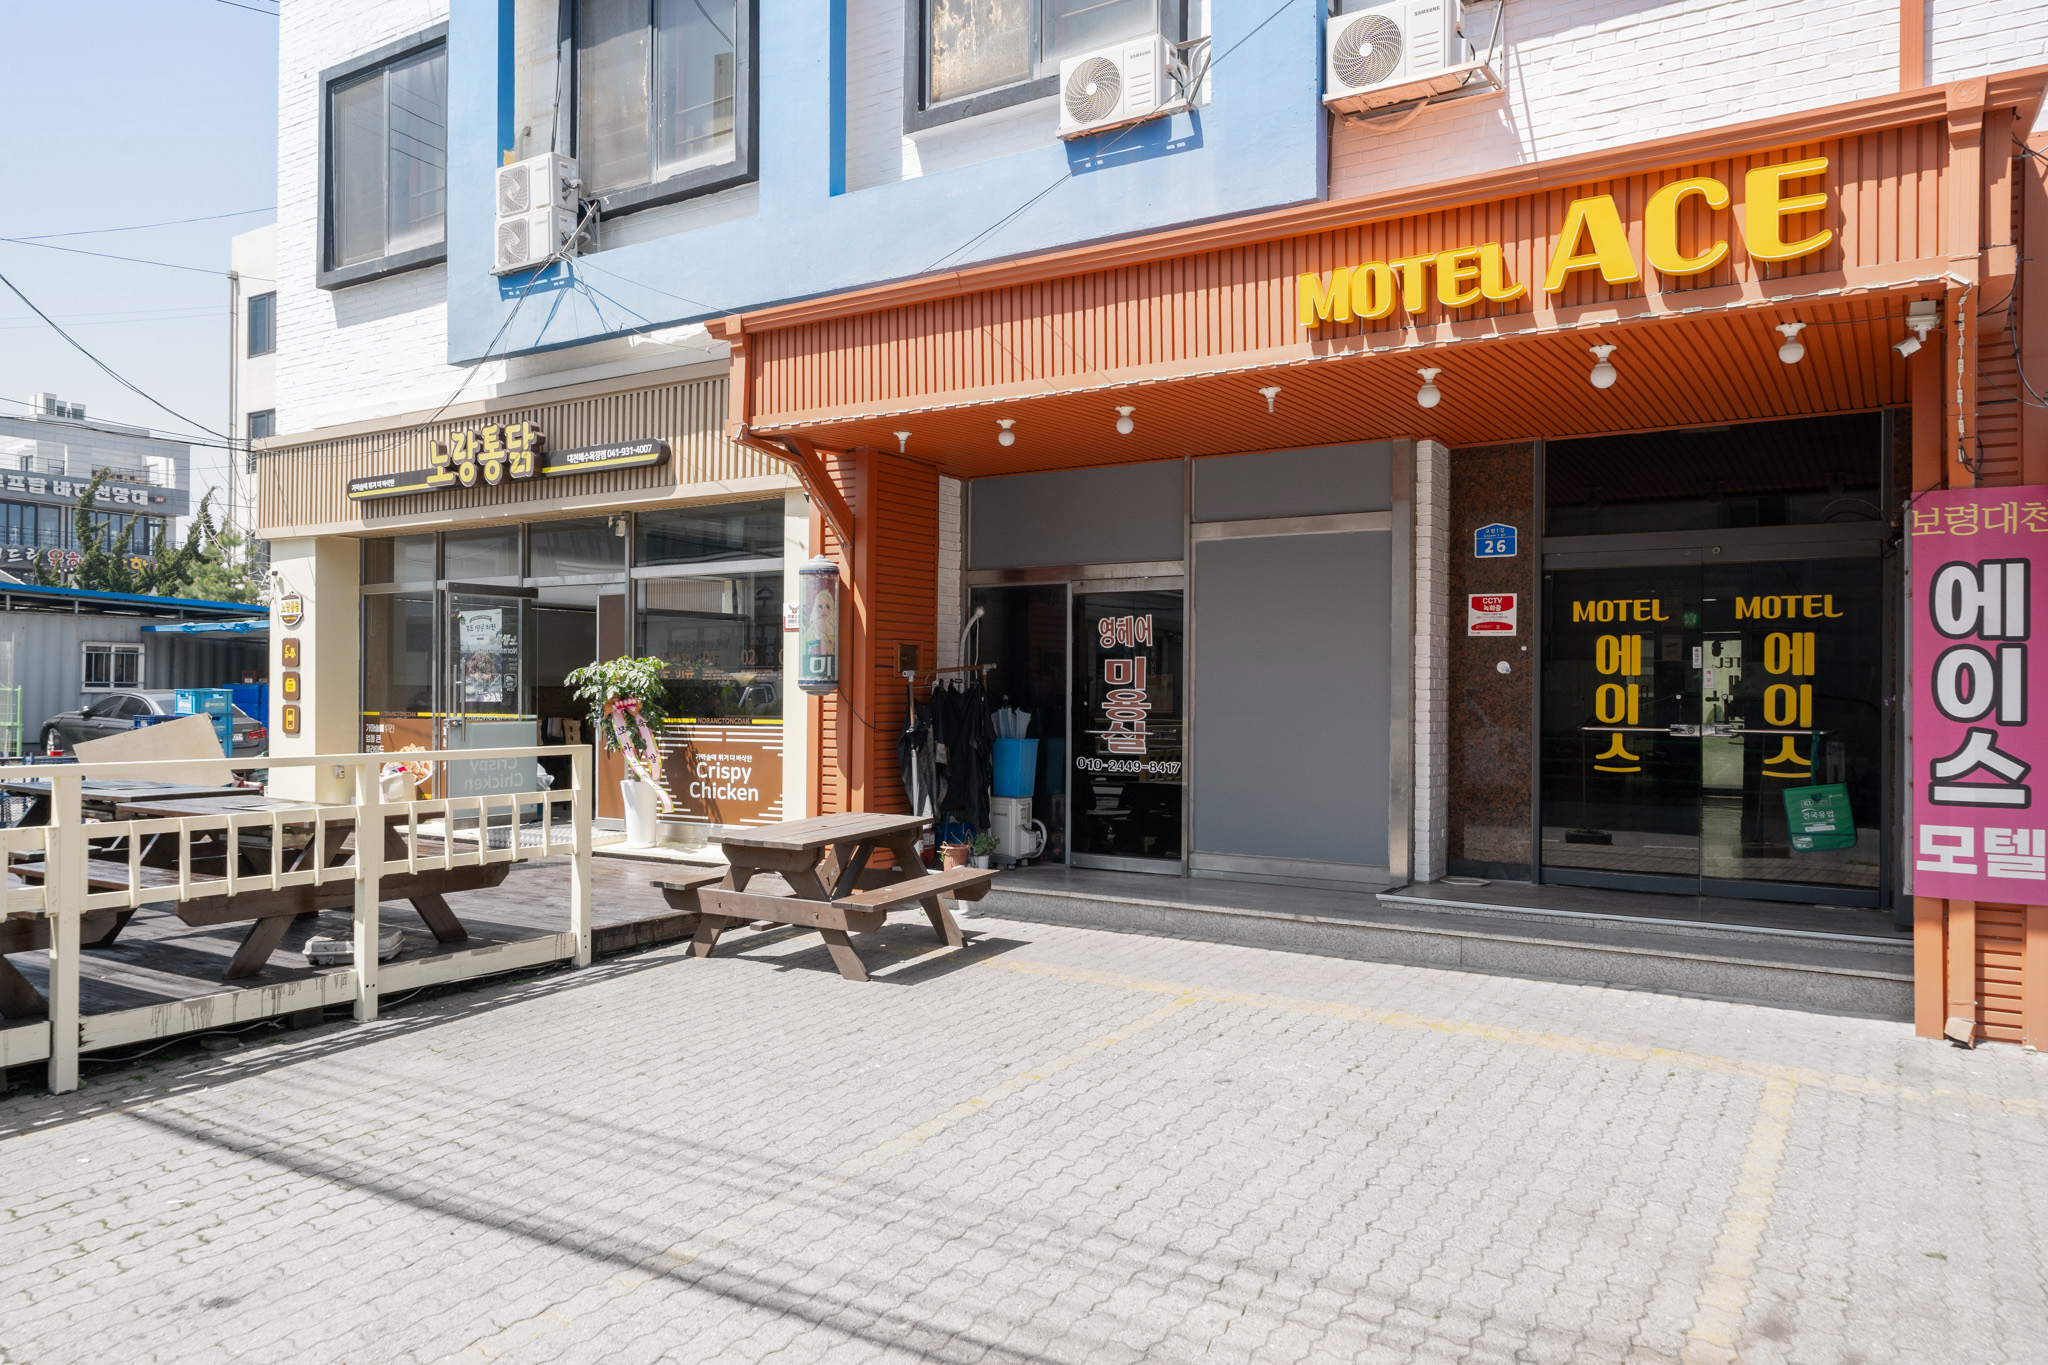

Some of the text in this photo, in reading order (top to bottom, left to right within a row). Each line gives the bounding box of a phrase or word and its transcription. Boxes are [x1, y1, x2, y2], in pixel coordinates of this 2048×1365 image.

[1414, 5, 1441, 17] SAMSUNG
[1130, 49, 1152, 60] SAMSUNG
[1299, 156, 1834, 329] MOTEL ACE
[426, 420, 544, 487] 노랑통닭
[567, 444, 653, 464] 대천해수욕장점 041-931-4007
[1911, 500, 2048, 538] 보령대천
[1484, 539, 1506, 554] 26
[1482, 597, 1503, 605] CCTV
[1572, 599, 1670, 623] MOTEL
[1735, 594, 1844, 620] MOTEL
[1098, 614, 1153, 648] 영헤어
[1928, 558, 2032, 809] 에이스
[1101, 656, 1152, 755] 미용실
[1594, 634, 1642, 773] 에이스
[1762, 631, 1816, 778] 에이스
[697, 717, 751, 725] NORANGTONGDAK
[695, 753, 717, 762] 가마솥에
[730, 754, 736, 762] 더
[736, 754, 752, 763] 바삭한
[1076, 756, 1181, 775] 010-2449-8417
[696, 761, 752, 785] Crispy
[689, 781, 759, 801] Chicken
[1802, 809, 1835, 820] 건국유업
[1916, 824, 2047, 882] 모텔
